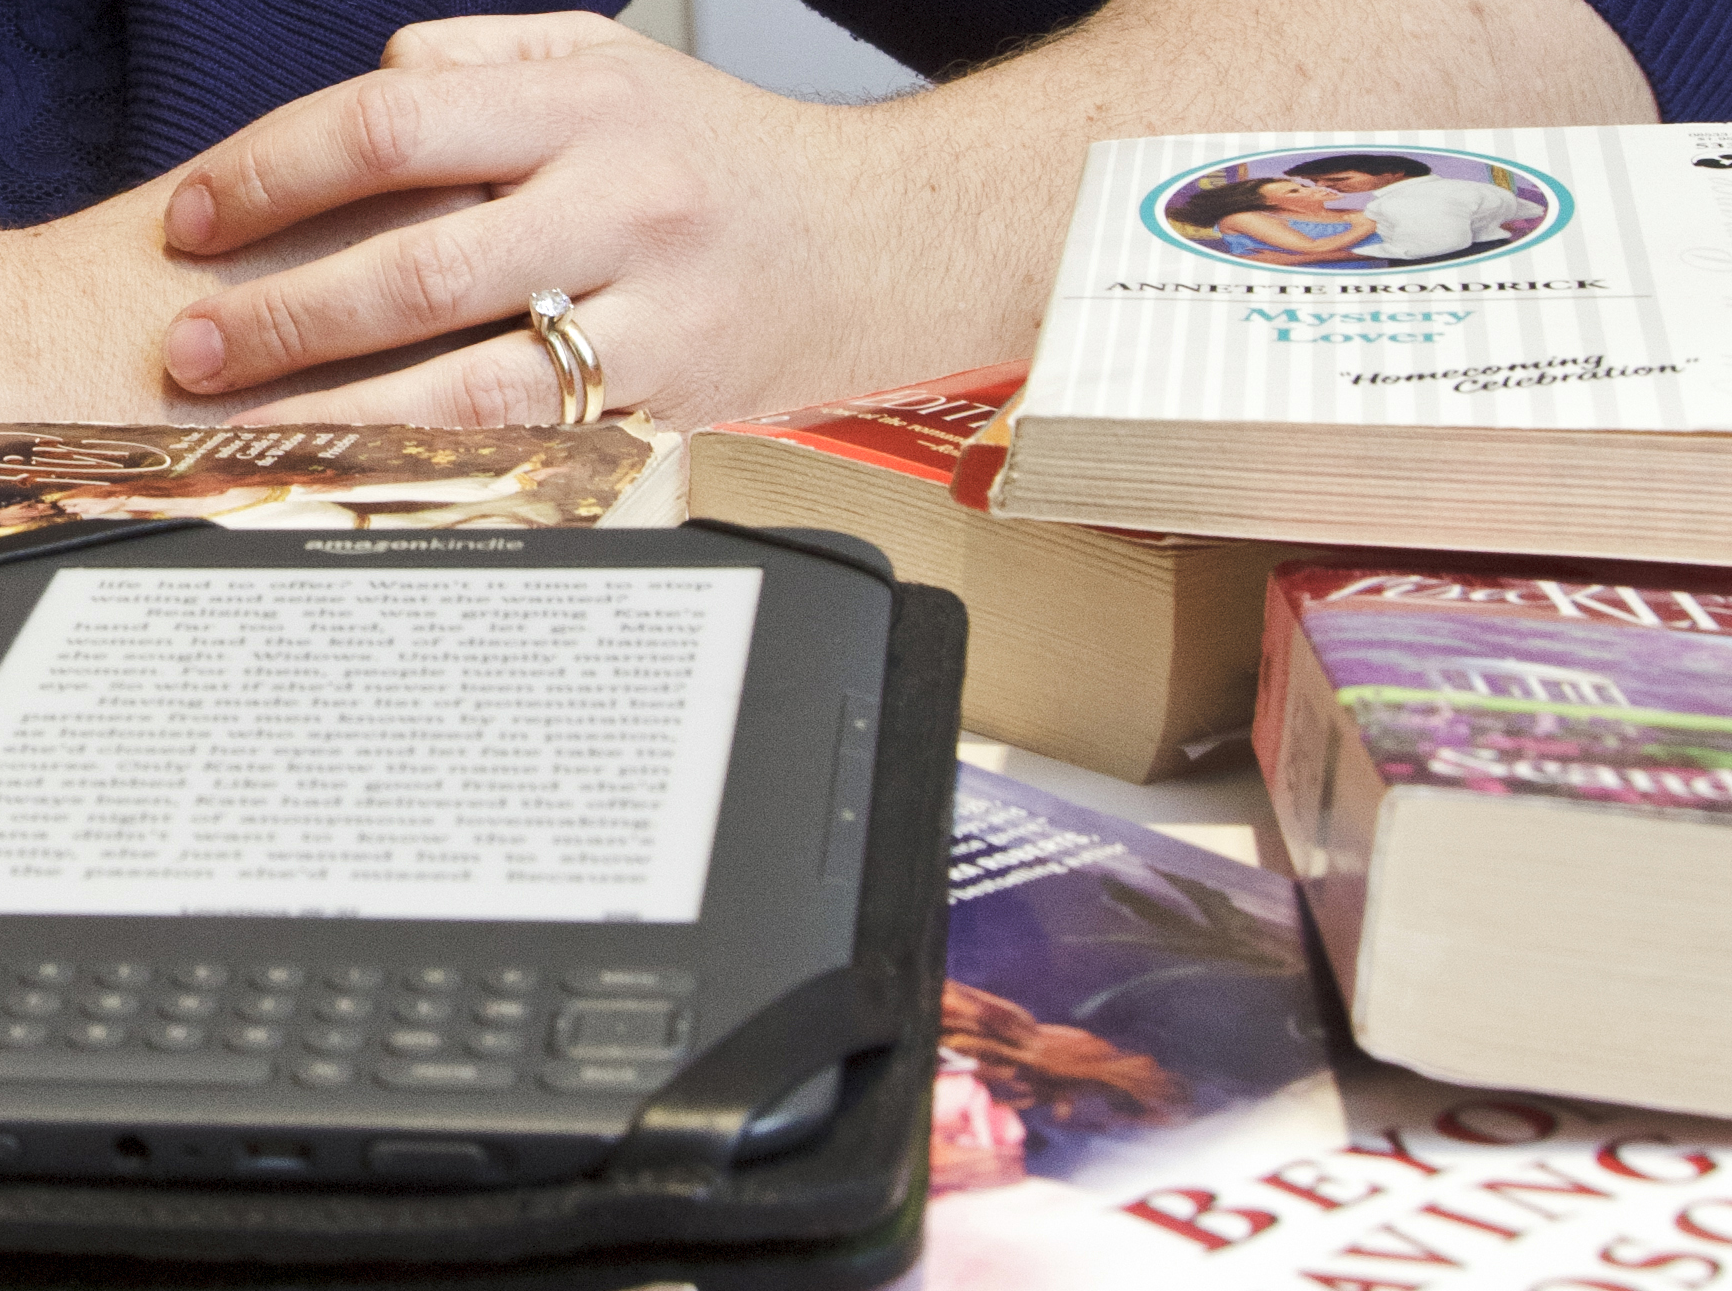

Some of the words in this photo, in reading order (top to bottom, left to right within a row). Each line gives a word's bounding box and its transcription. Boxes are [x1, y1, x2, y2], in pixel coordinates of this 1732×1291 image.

[1105, 281, 1328, 295] ANNETTE
[1338, 278, 1612, 295] BROADRICK
[1239, 307, 1477, 327] Mystery
[1271, 327, 1447, 345] Lover
[850, 389, 998, 428] EDIT
[1118, 1100, 1559, 1256] BEYO
